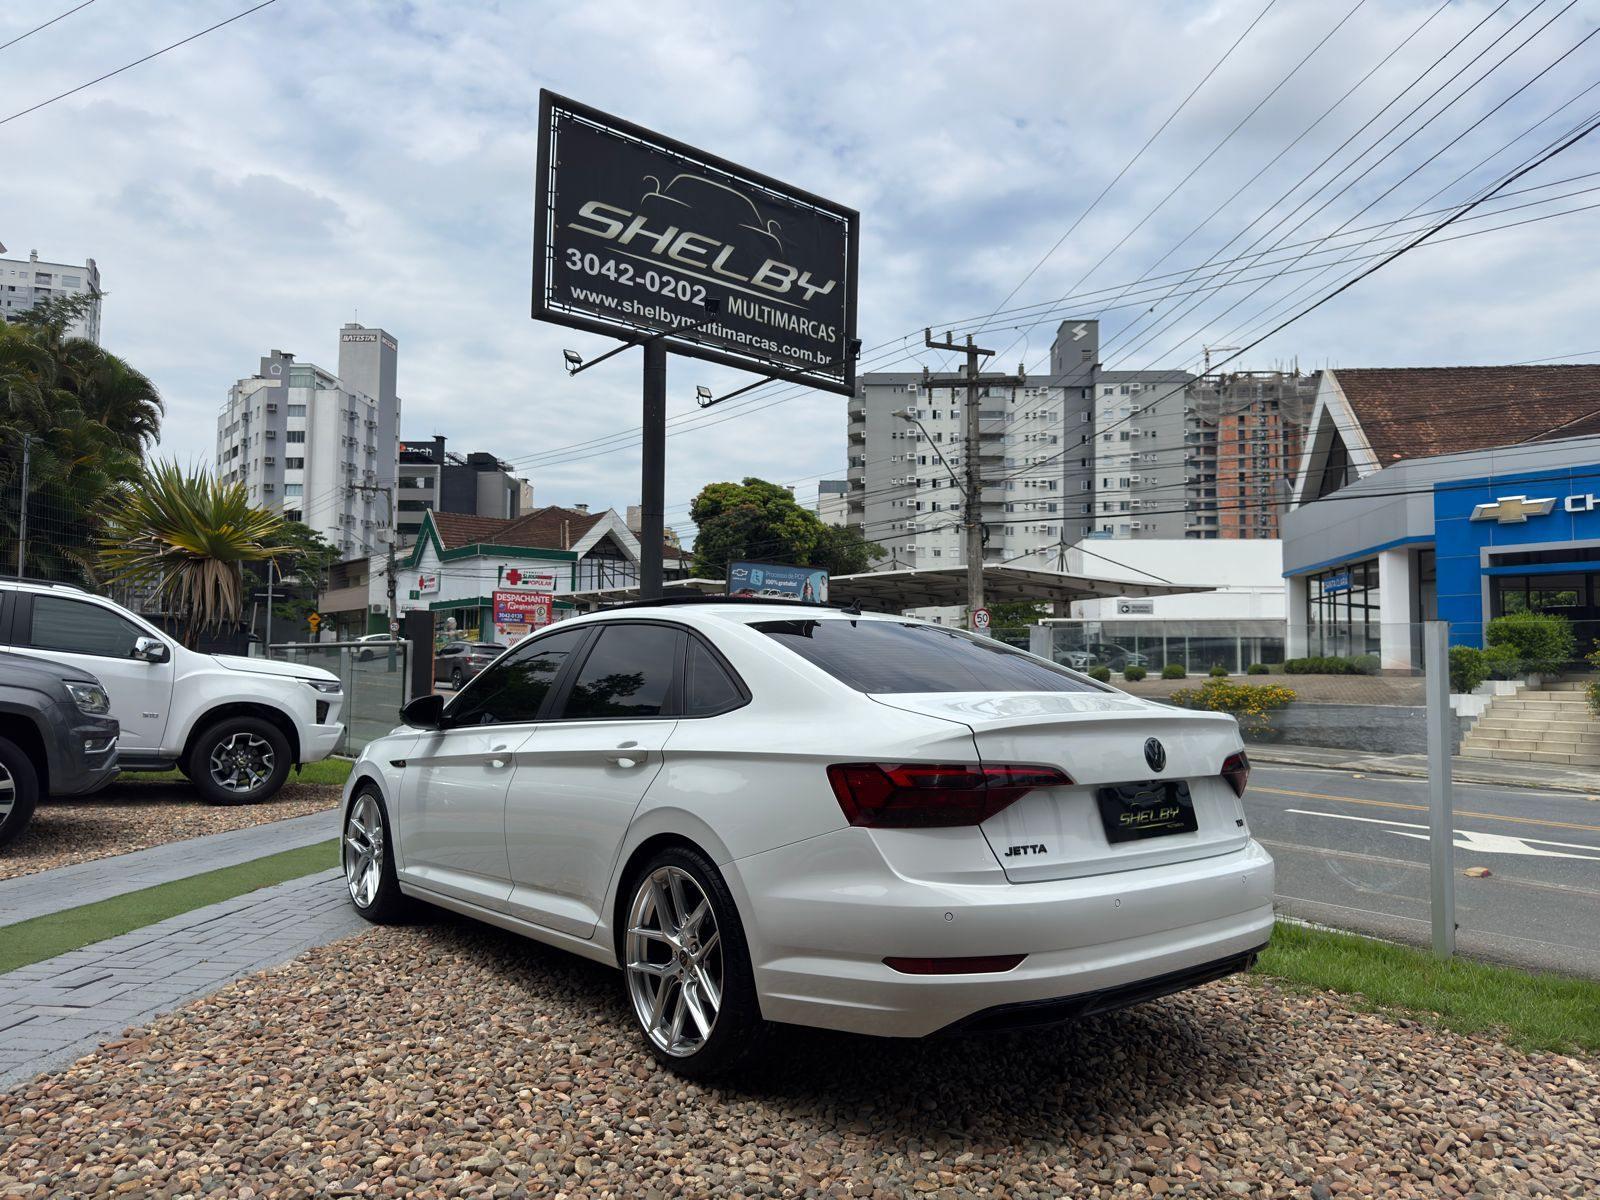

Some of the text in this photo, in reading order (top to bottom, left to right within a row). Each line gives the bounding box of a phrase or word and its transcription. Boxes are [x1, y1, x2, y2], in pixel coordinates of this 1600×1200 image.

[568, 200, 837, 301] SHELBY
[565, 248, 707, 307] 3042-0202
[570, 285, 833, 365] www.shelbymultimarcas.com.br
[727, 295, 836, 343] MULTIMARCAS
[496, 593, 551, 604] DESPACHANTE
[976, 613, 988, 623] 50
[1119, 806, 1180, 825] SHELBY
[1004, 843, 1048, 857] JETTA
